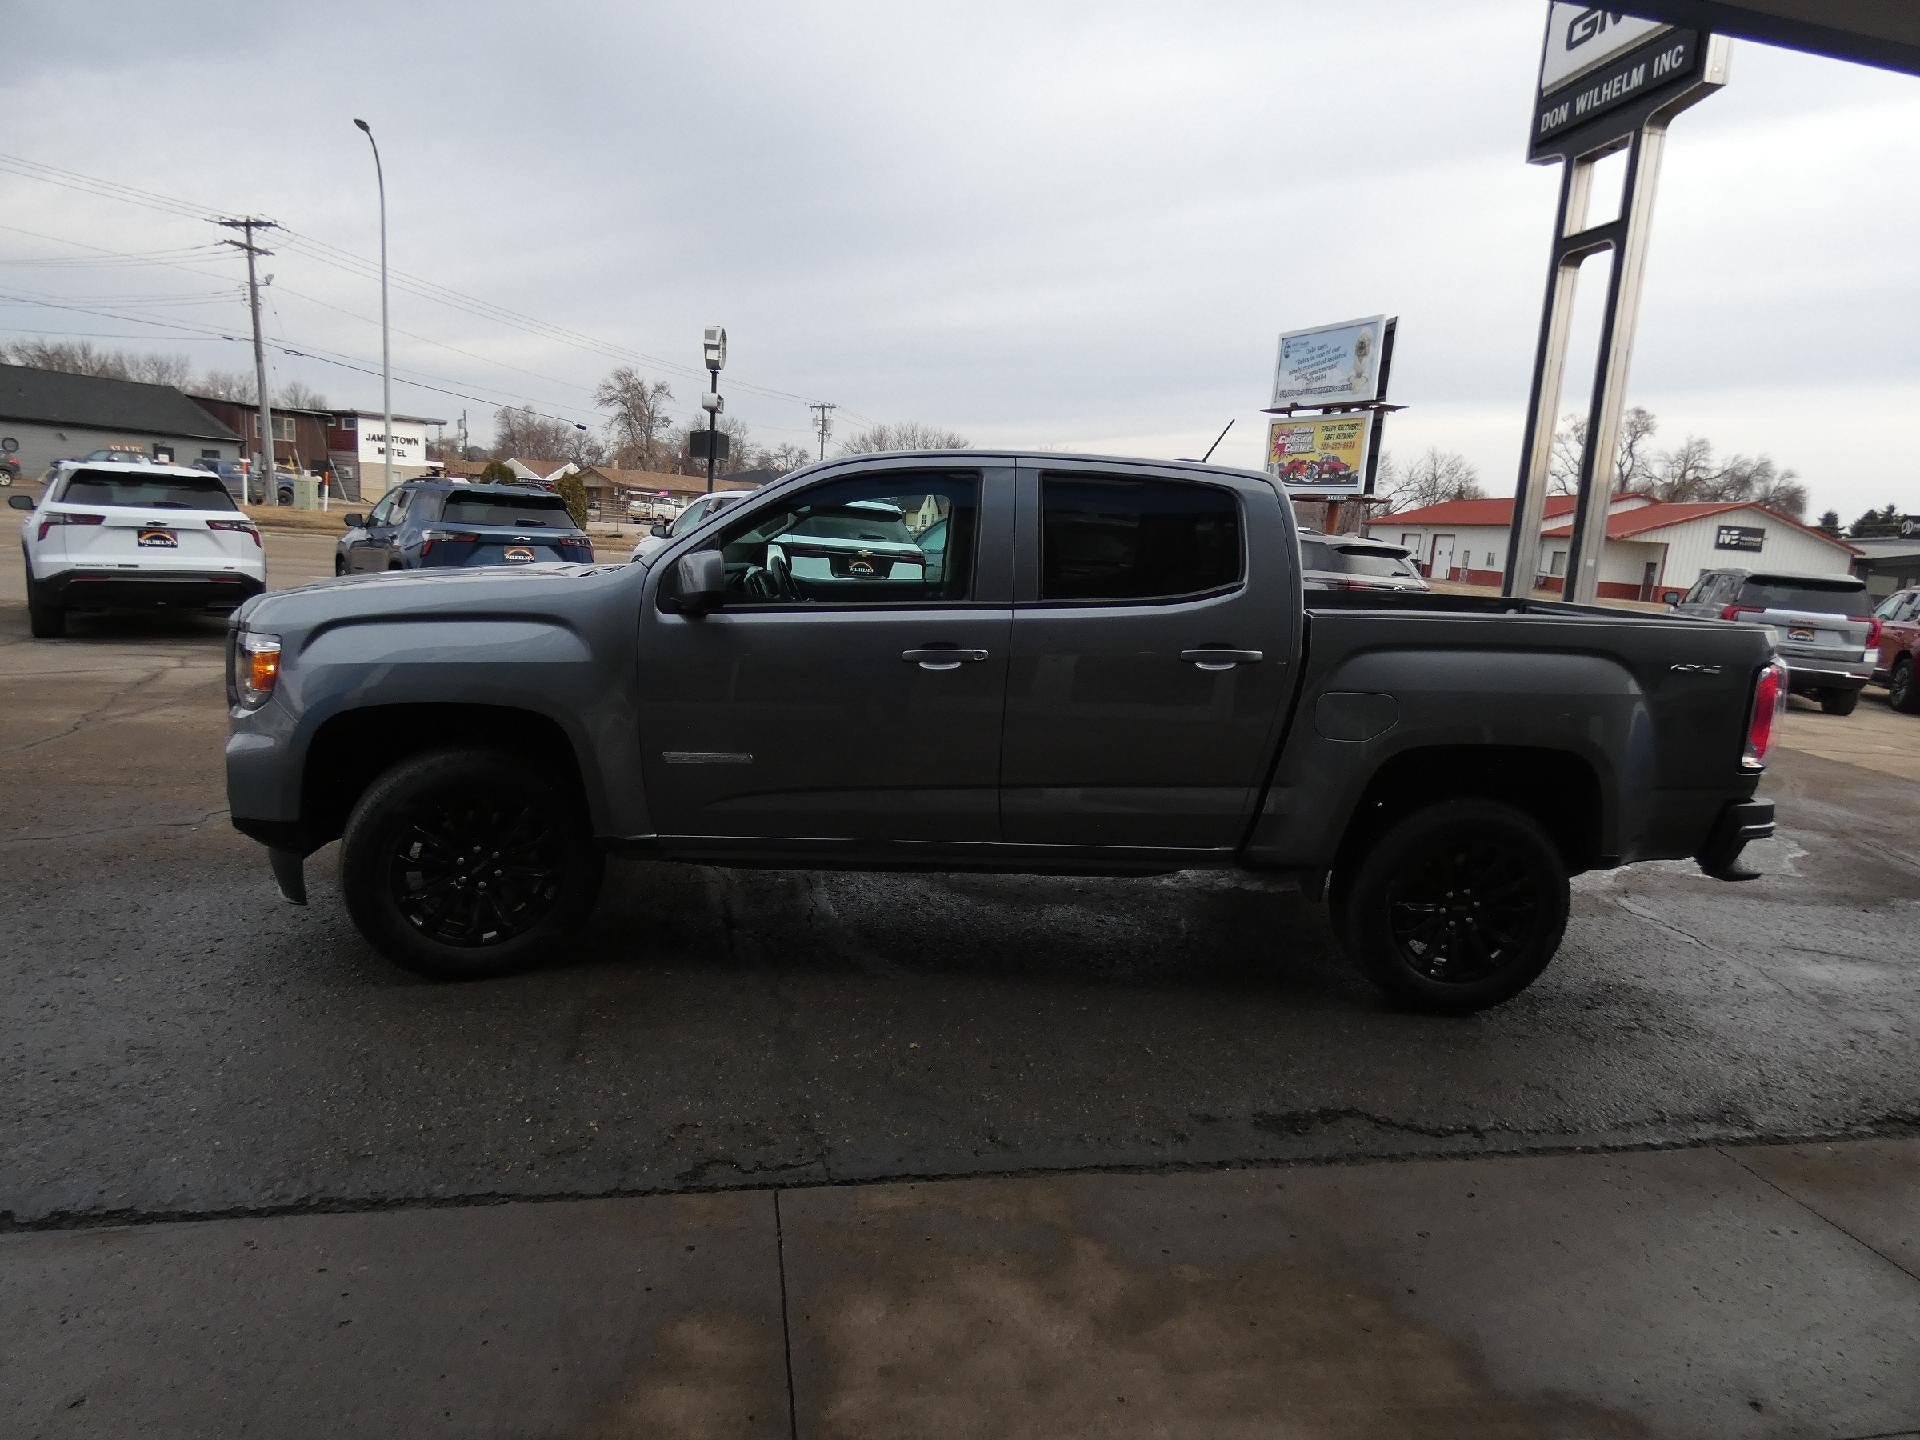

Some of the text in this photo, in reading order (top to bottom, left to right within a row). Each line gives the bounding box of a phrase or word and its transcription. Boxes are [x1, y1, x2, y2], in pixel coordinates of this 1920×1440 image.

[1566, 8, 1623, 51] GM
[1540, 45, 1684, 132] DON WILHELM INC
[377, 447, 407, 457] MTEL
